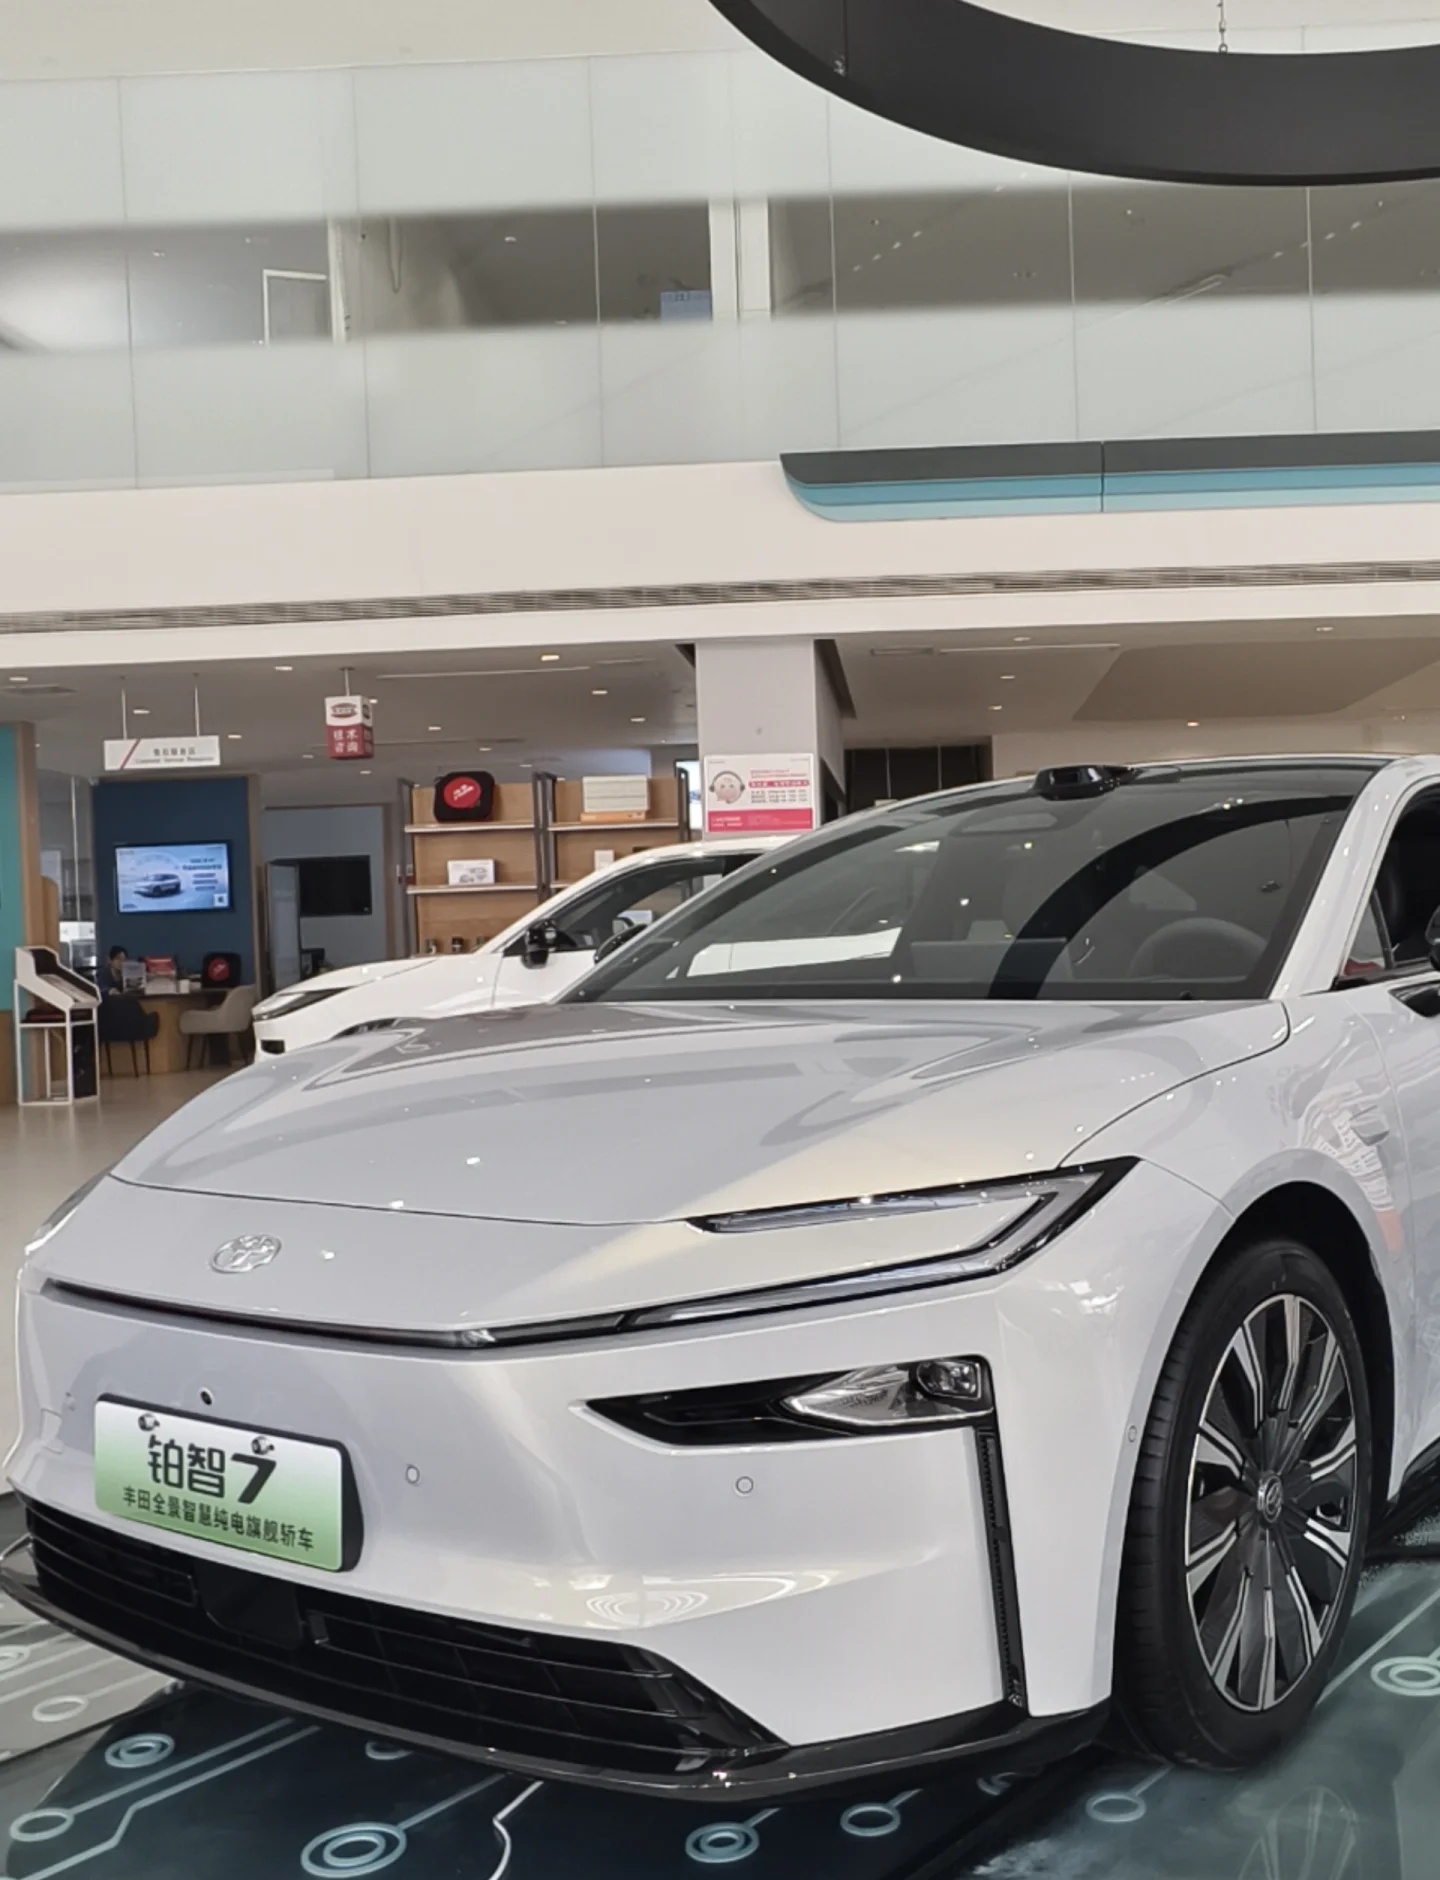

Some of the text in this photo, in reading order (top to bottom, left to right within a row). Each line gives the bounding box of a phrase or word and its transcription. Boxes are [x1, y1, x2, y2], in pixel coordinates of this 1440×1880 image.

[148, 1434, 278, 1504] 铂智7
[123, 1486, 314, 1551] 丰田全景智慧纯电旗舰轿车
